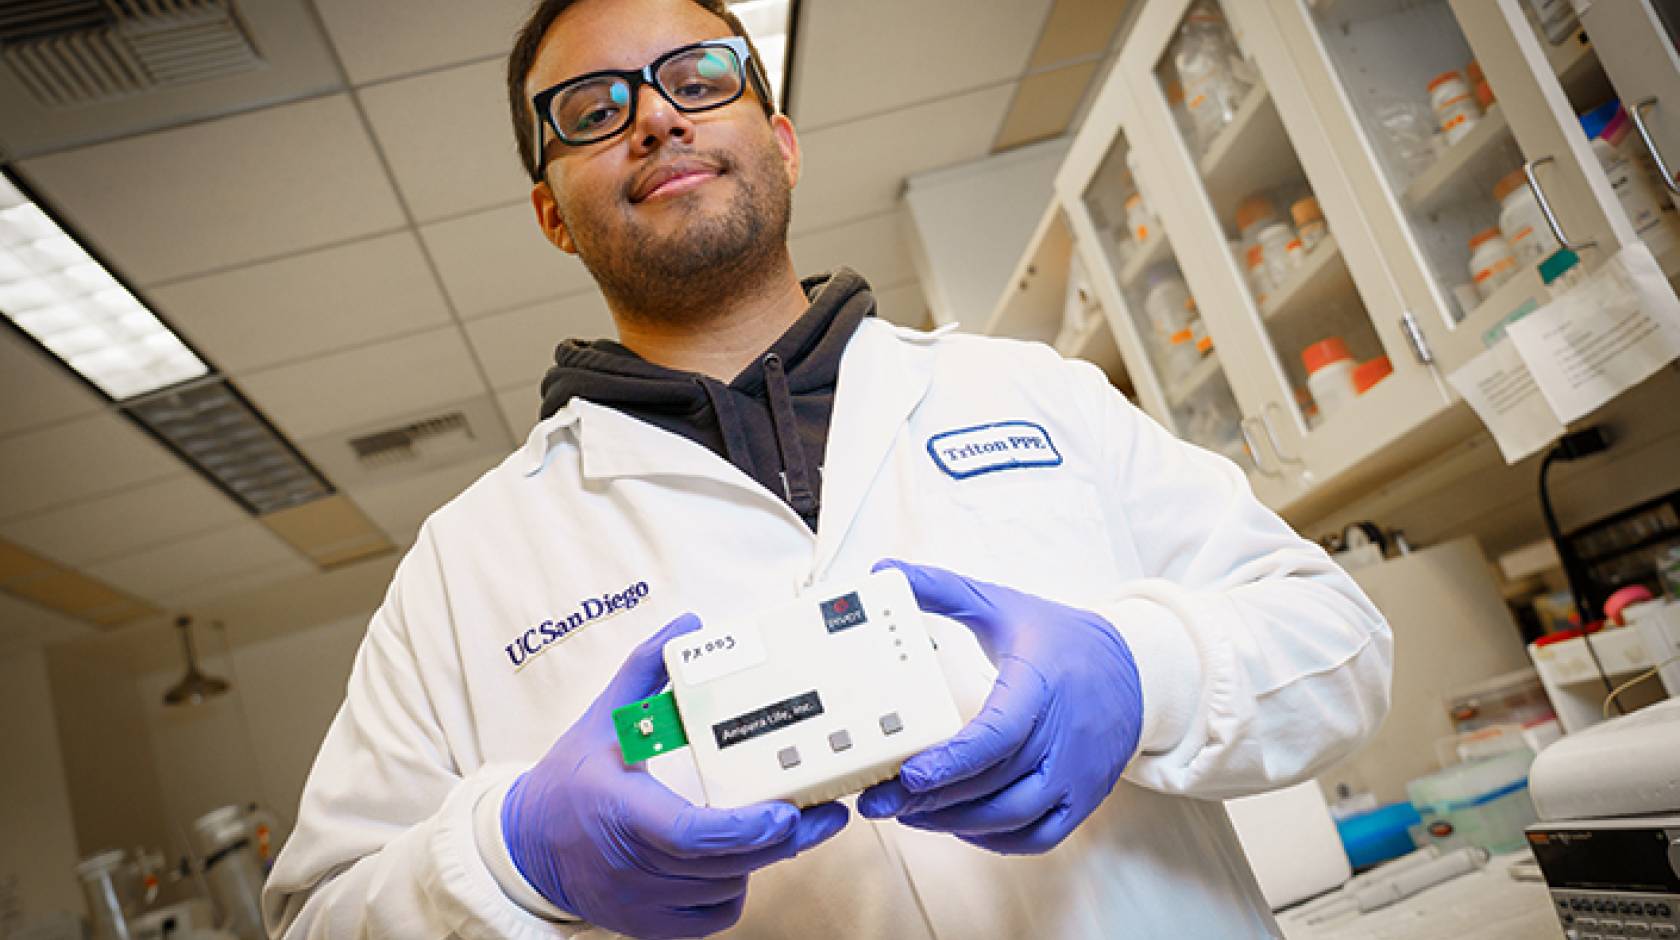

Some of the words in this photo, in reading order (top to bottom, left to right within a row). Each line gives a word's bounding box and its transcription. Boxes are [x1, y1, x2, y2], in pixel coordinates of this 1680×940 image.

[943, 441, 1009, 461] Triton
[504, 627, 541, 665] UC
[538, 612, 584, 644] San
[580, 581, 649, 620] Diego
